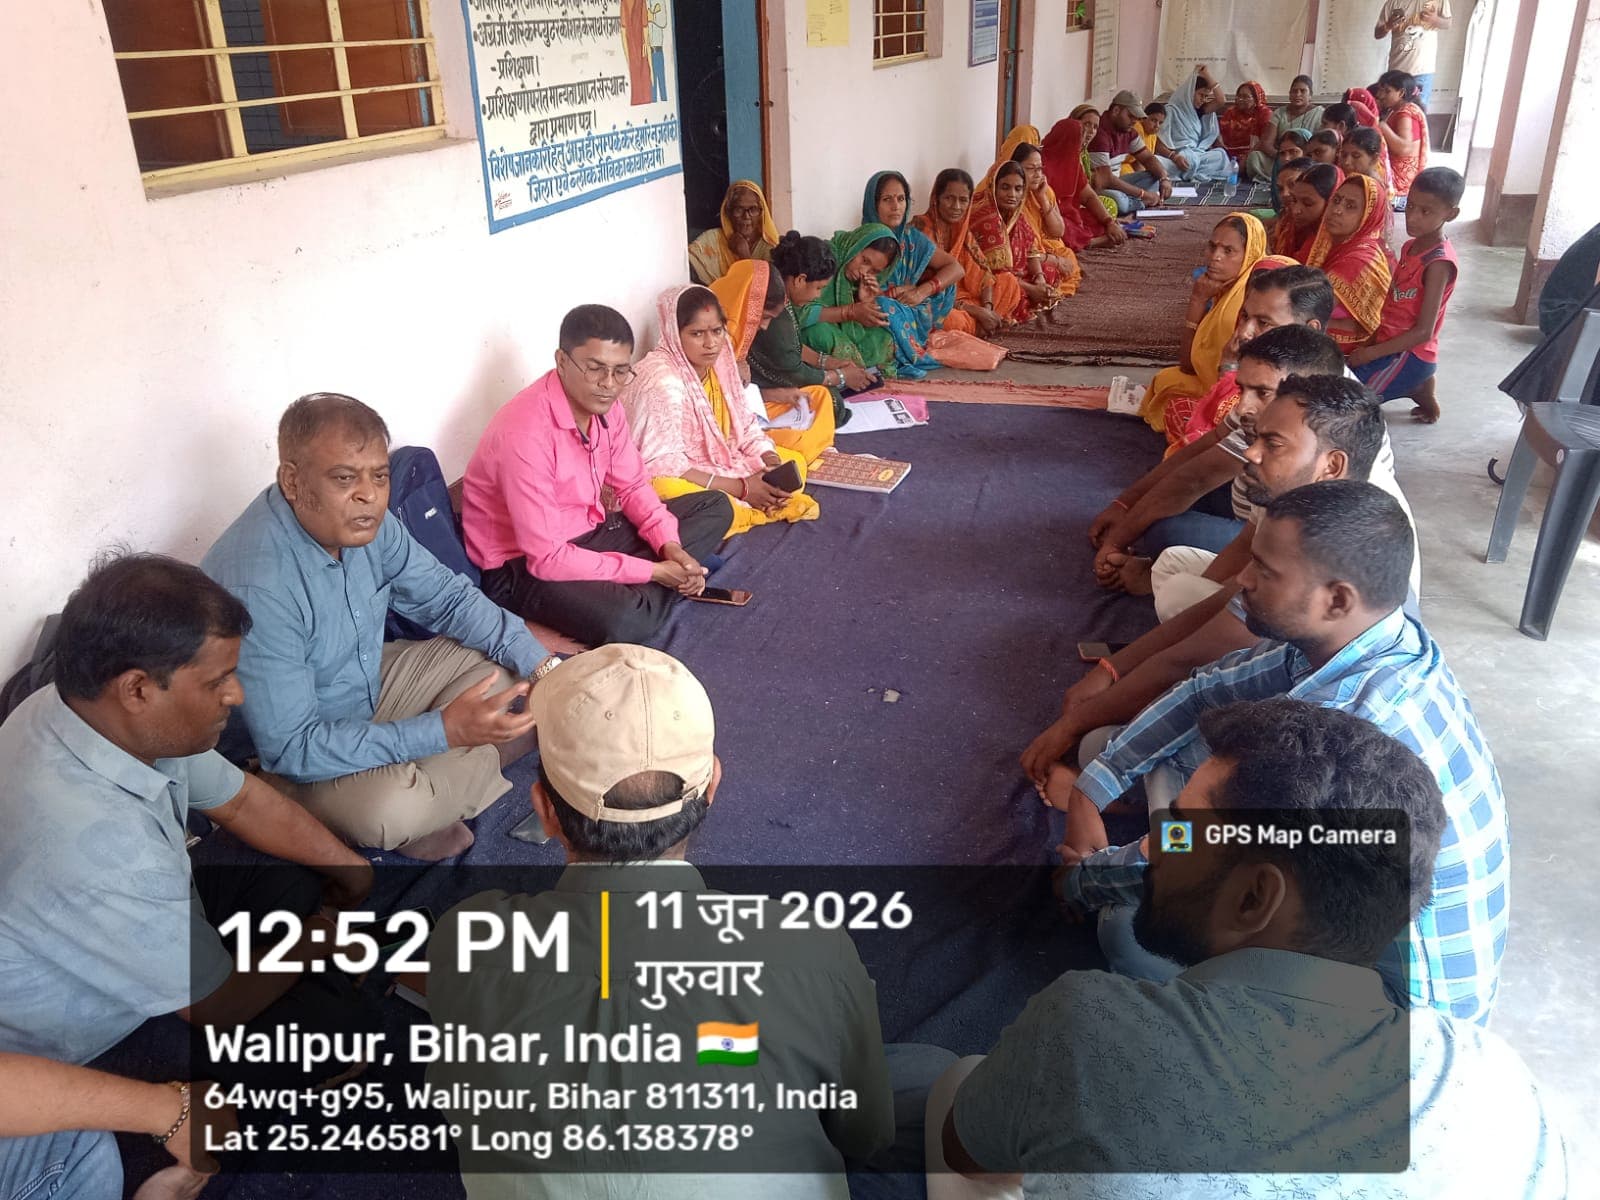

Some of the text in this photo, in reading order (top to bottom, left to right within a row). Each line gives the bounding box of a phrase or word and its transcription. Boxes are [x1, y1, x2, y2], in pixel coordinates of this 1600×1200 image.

[529, 118, 549, 147] द्वारा
[549, 113, 577, 142] प्रमाण
[527, 174, 554, 203] जिला
